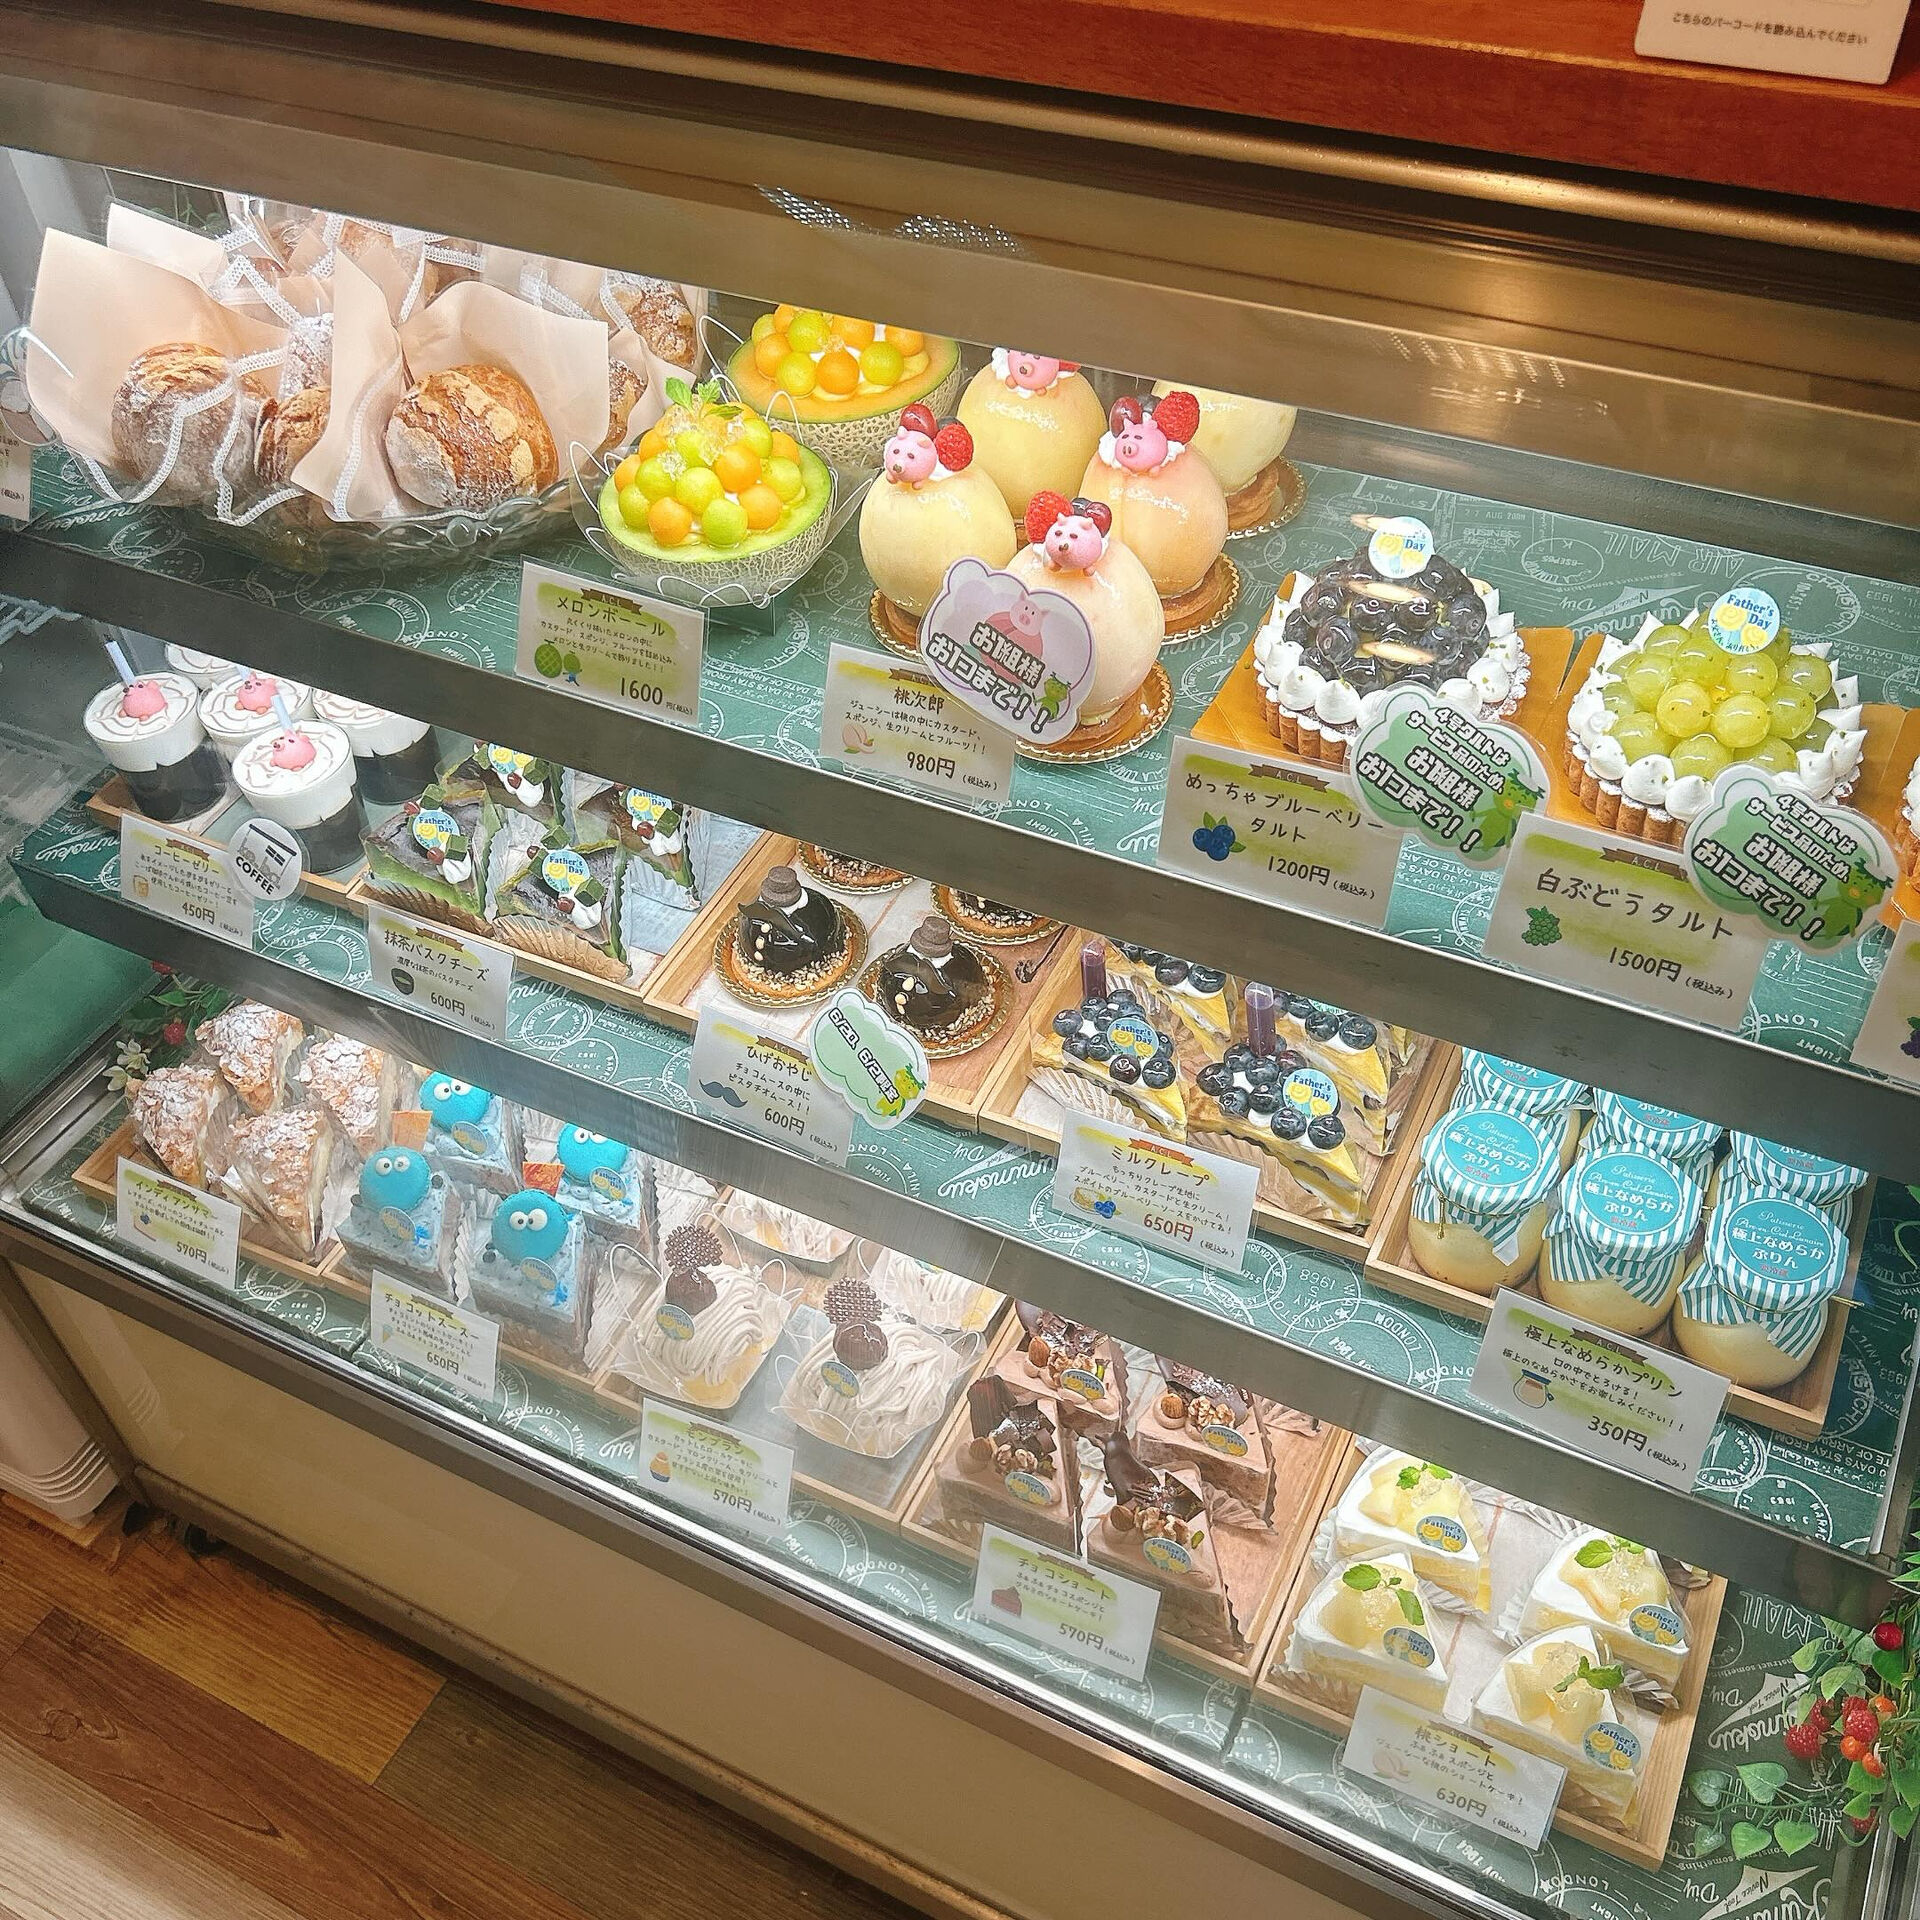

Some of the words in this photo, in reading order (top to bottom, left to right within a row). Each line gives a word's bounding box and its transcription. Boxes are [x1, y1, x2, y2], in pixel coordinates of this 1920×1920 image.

[1672, 12, 1869, 45] こちらのバーコードを読み込んでください
[1405, 539, 1425, 552] Day
[1603, 529, 1680, 567] MAIL
[1688, 547, 1745, 578] AIR
[1559, 595, 1597, 611] Diy
[1727, 594, 1774, 617] Father's
[1748, 614, 1772, 630] Day
[620, 678, 663, 705] 1600
[732, 675, 756, 690] STAY
[756, 682, 782, 697] DAYS
[766, 677, 782, 689] OF
[784, 681, 809, 694] DATE
[894, 686, 945, 715] 桃次郎
[1435, 707, 1511, 766] 4号タルトは
[907, 752, 956, 780] 980円
[651, 798, 668, 808] Day
[1185, 773, 1384, 831] めっちゃブルーベリー
[418, 816, 452, 826] Father's
[438, 825, 454, 834] Day
[1250, 816, 1307, 843] タルト
[155, 845, 219, 874] コーヒーゼリー
[549, 856, 583, 867] Father's
[568, 865, 584, 876] Day
[1409, 863, 1441, 877] DAYS
[236, 856, 274, 895] COFFEE
[1267, 855, 1331, 887] 1200円
[1334, 879, 1376, 900] (税込み)
[1443, 873, 1457, 883] 30
[182, 902, 215, 925] 450円
[1536, 868, 1734, 941] 白ぶどうタルト
[384, 929, 490, 982] 抹茶バスクチーズ
[1609, 947, 1682, 983] 1500円
[1686, 977, 1734, 999] (税込み)
[430, 992, 465, 1017] 600円
[1115, 1023, 1152, 1037] Father's
[1134, 1034, 1153, 1045] Day
[1795, 1038, 1842, 1063] FLIGHT
[746, 1046, 813, 1082] ひげおやじ
[735, 1062, 810, 1100] チョコムースの中に
[1292, 1074, 1332, 1092] Father's
[728, 1073, 810, 1116] ピスタチオムース！！
[1312, 1090, 1332, 1101] Day
[764, 1108, 805, 1137] 600円
[953, 1143, 984, 1161] Diy
[1448, 1131, 1531, 1171] 極上なめらか
[1462, 1152, 1501, 1175] ぷりん
[1112, 1146, 1210, 1187] ミルクレープ
[1112, 1165, 1201, 1201] もっちりクレープ生地に
[136, 1181, 218, 1220] インディアンサマー
[1585, 1181, 1674, 1213] 極上なめらか
[1604, 1201, 1648, 1221] ぷりん
[1143, 1213, 1194, 1243] 650円
[1732, 1227, 1825, 1260] 極上なめらか
[1752, 1248, 1798, 1269] ぷりん
[1299, 1268, 1336, 1290] 1968
[385, 1293, 479, 1339] チョコットスースー
[427, 1352, 459, 1375] 650円
[1523, 1324, 1683, 1399] 極上なめらかプリン
[1502, 1347, 1684, 1432] 極上のなめらかさをお楽しみください！！
[1553, 1356, 1640, 1400] 口の中でとろける！
[686, 1429, 744, 1455] モンブラン
[1587, 1415, 1648, 1452] 350円
[713, 1489, 752, 1513] 570円
[1425, 1517, 1463, 1534] Father's
[1444, 1529, 1463, 1542] Day
[1018, 1557, 1110, 1600] チョコショート
[1641, 1606, 1683, 1629] Father's
[1658, 1622, 1678, 1637] Day
[1738, 1590, 1812, 1646] MAIL
[1059, 1623, 1104, 1650] 570円
[1710, 1688, 1742, 1708] Diy
[1415, 1725, 1496, 1767] 桃ショート
[1596, 1724, 1638, 1747] Father's
[1614, 1742, 1636, 1758] Day
[1436, 1787, 1488, 1818] 630円
[1677, 1855, 1734, 1873] something
[1681, 1878, 1720, 1904] Diy
